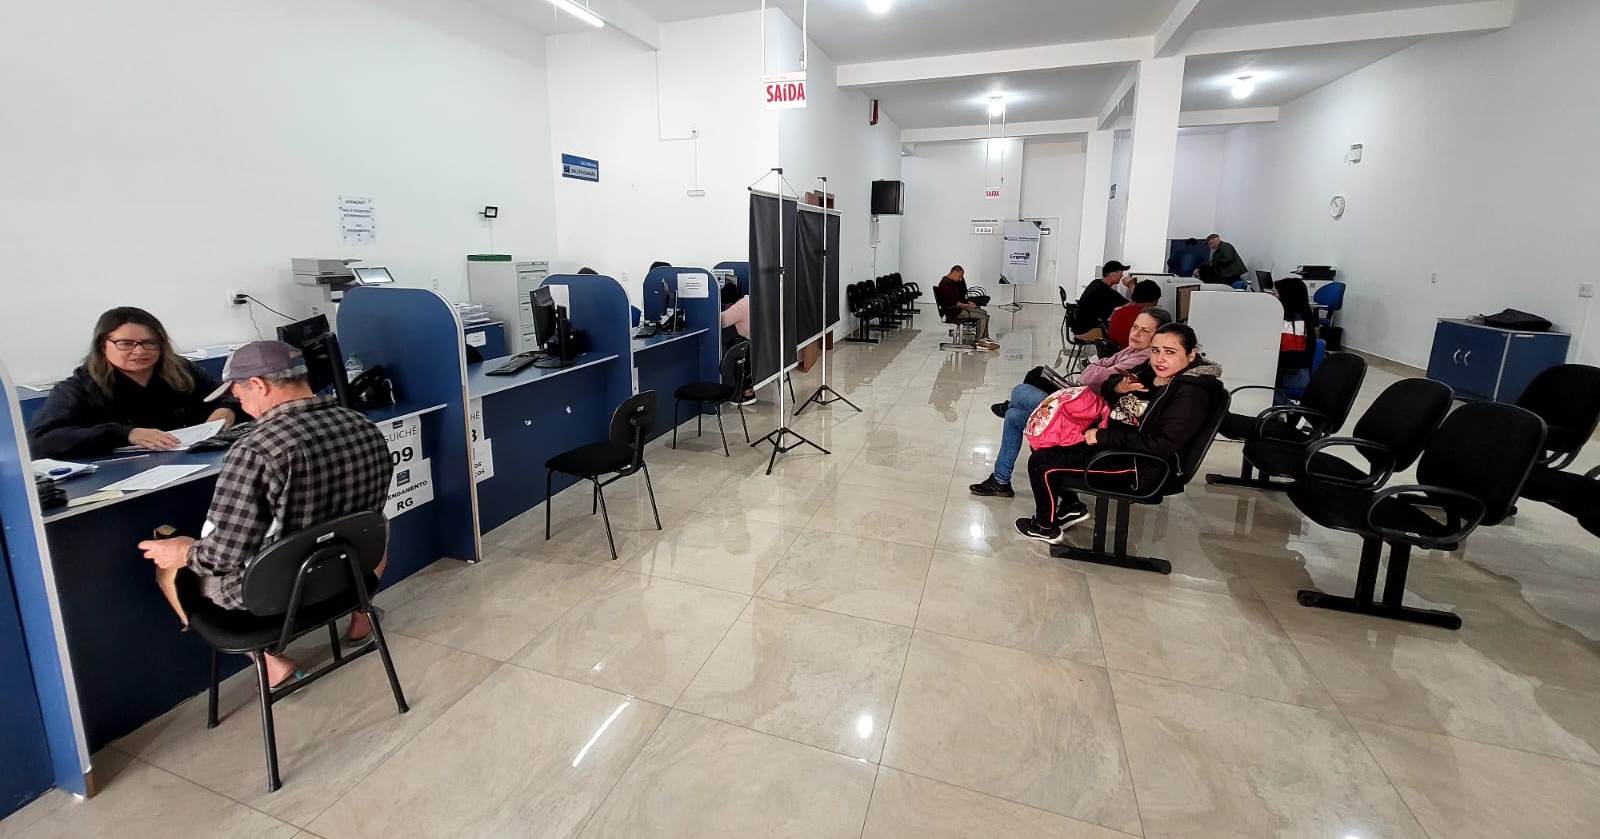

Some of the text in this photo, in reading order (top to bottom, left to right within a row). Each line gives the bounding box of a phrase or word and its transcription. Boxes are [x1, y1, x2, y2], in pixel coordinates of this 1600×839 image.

[391, 446, 414, 466] 09
[387, 480, 428, 501] ENDAMENTO
[396, 497, 414, 511] RG
